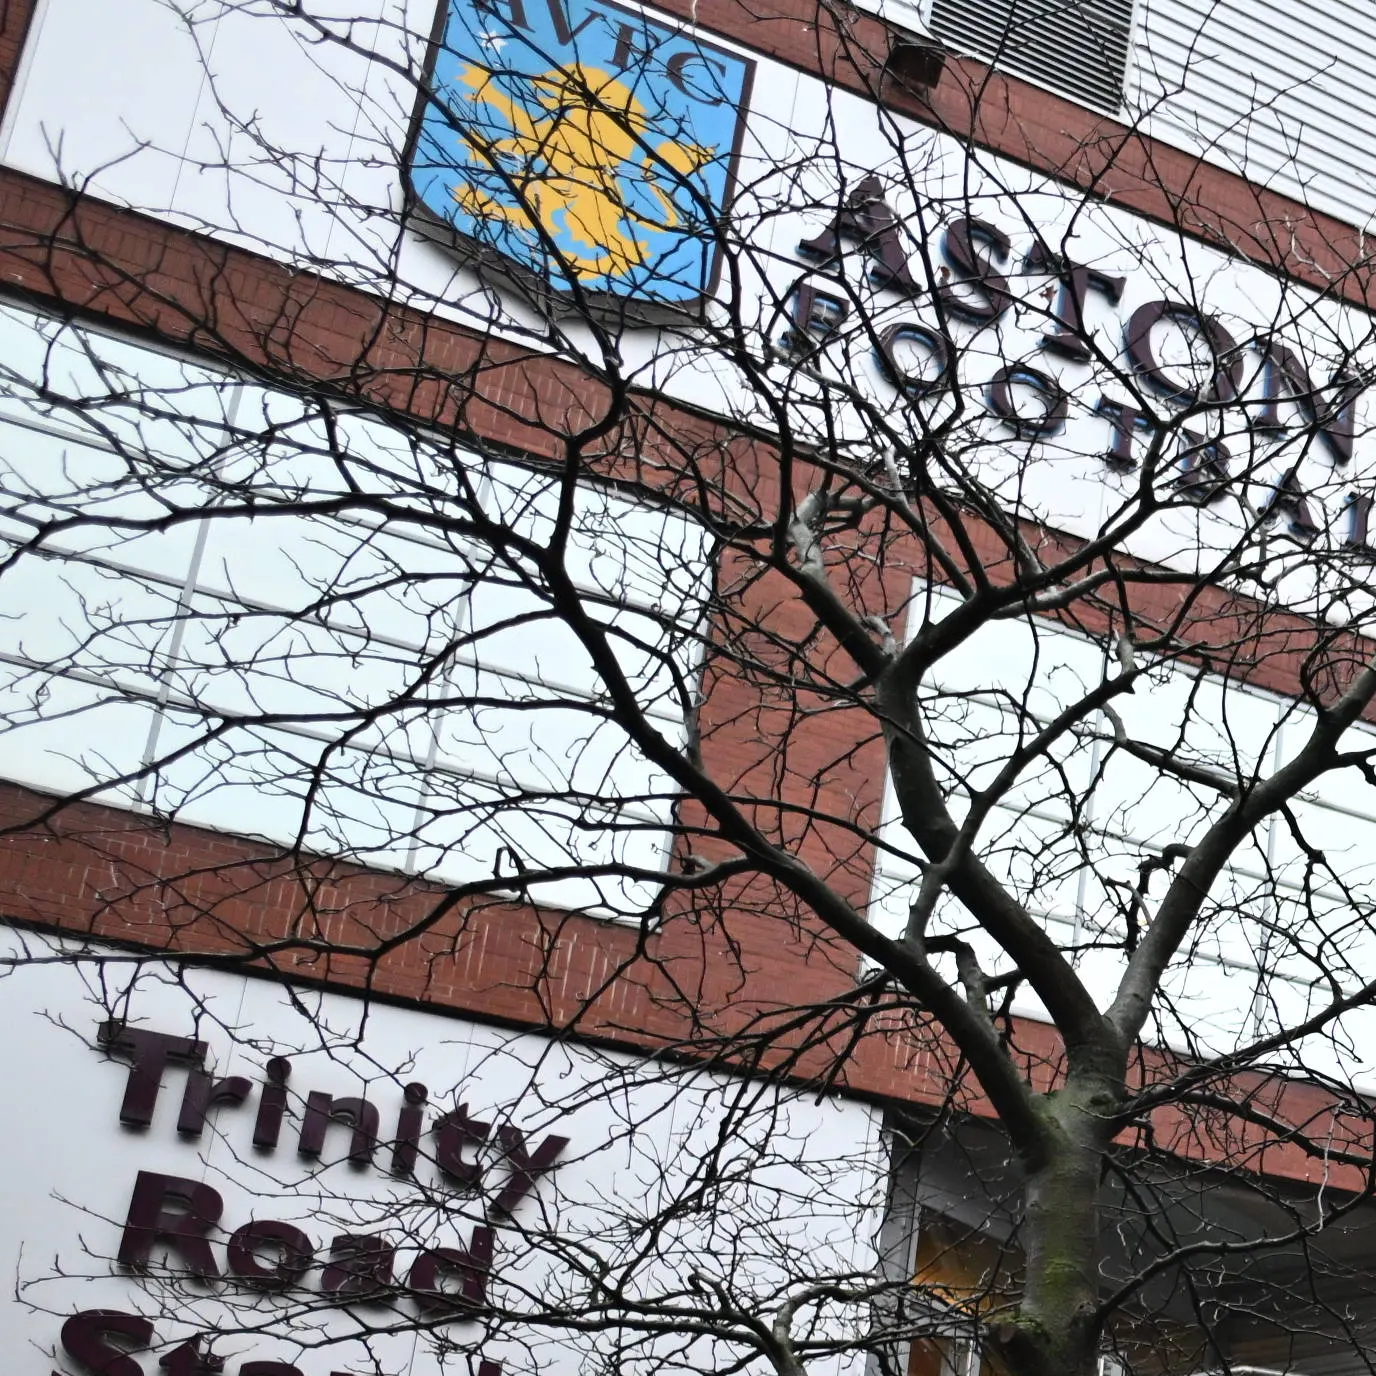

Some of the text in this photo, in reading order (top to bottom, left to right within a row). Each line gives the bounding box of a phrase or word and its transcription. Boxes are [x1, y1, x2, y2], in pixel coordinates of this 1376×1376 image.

[797, 174, 1356, 466] ASTON
[98, 1019, 571, 1219] Trinity
[117, 1170, 496, 1314] Road
